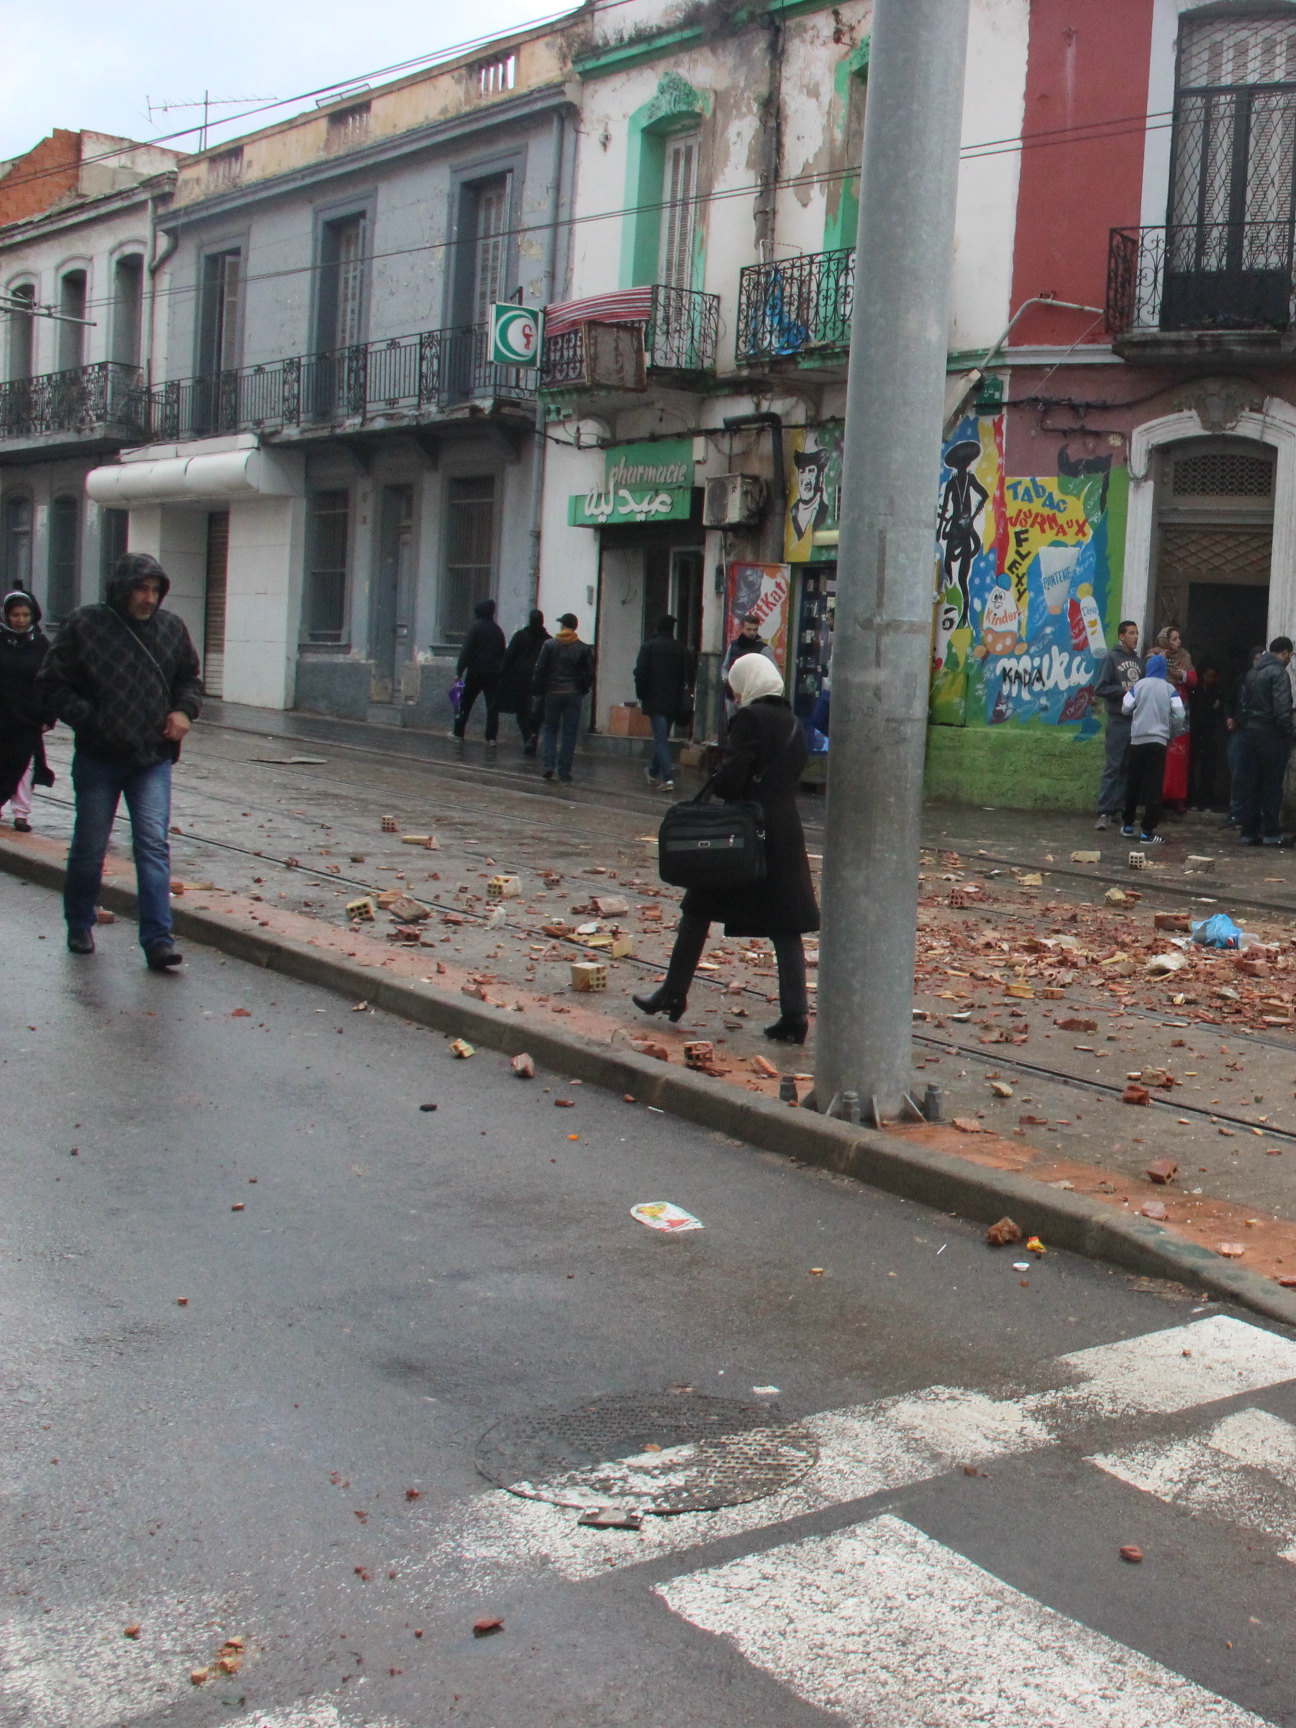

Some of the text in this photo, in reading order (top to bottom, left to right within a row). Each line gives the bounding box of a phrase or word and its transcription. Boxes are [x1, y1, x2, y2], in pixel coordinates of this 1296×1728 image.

[610, 456, 688, 486] pharmacie
[1007, 508, 1089, 538] JOURNAUX
[985, 608, 1020, 626] Kinder
